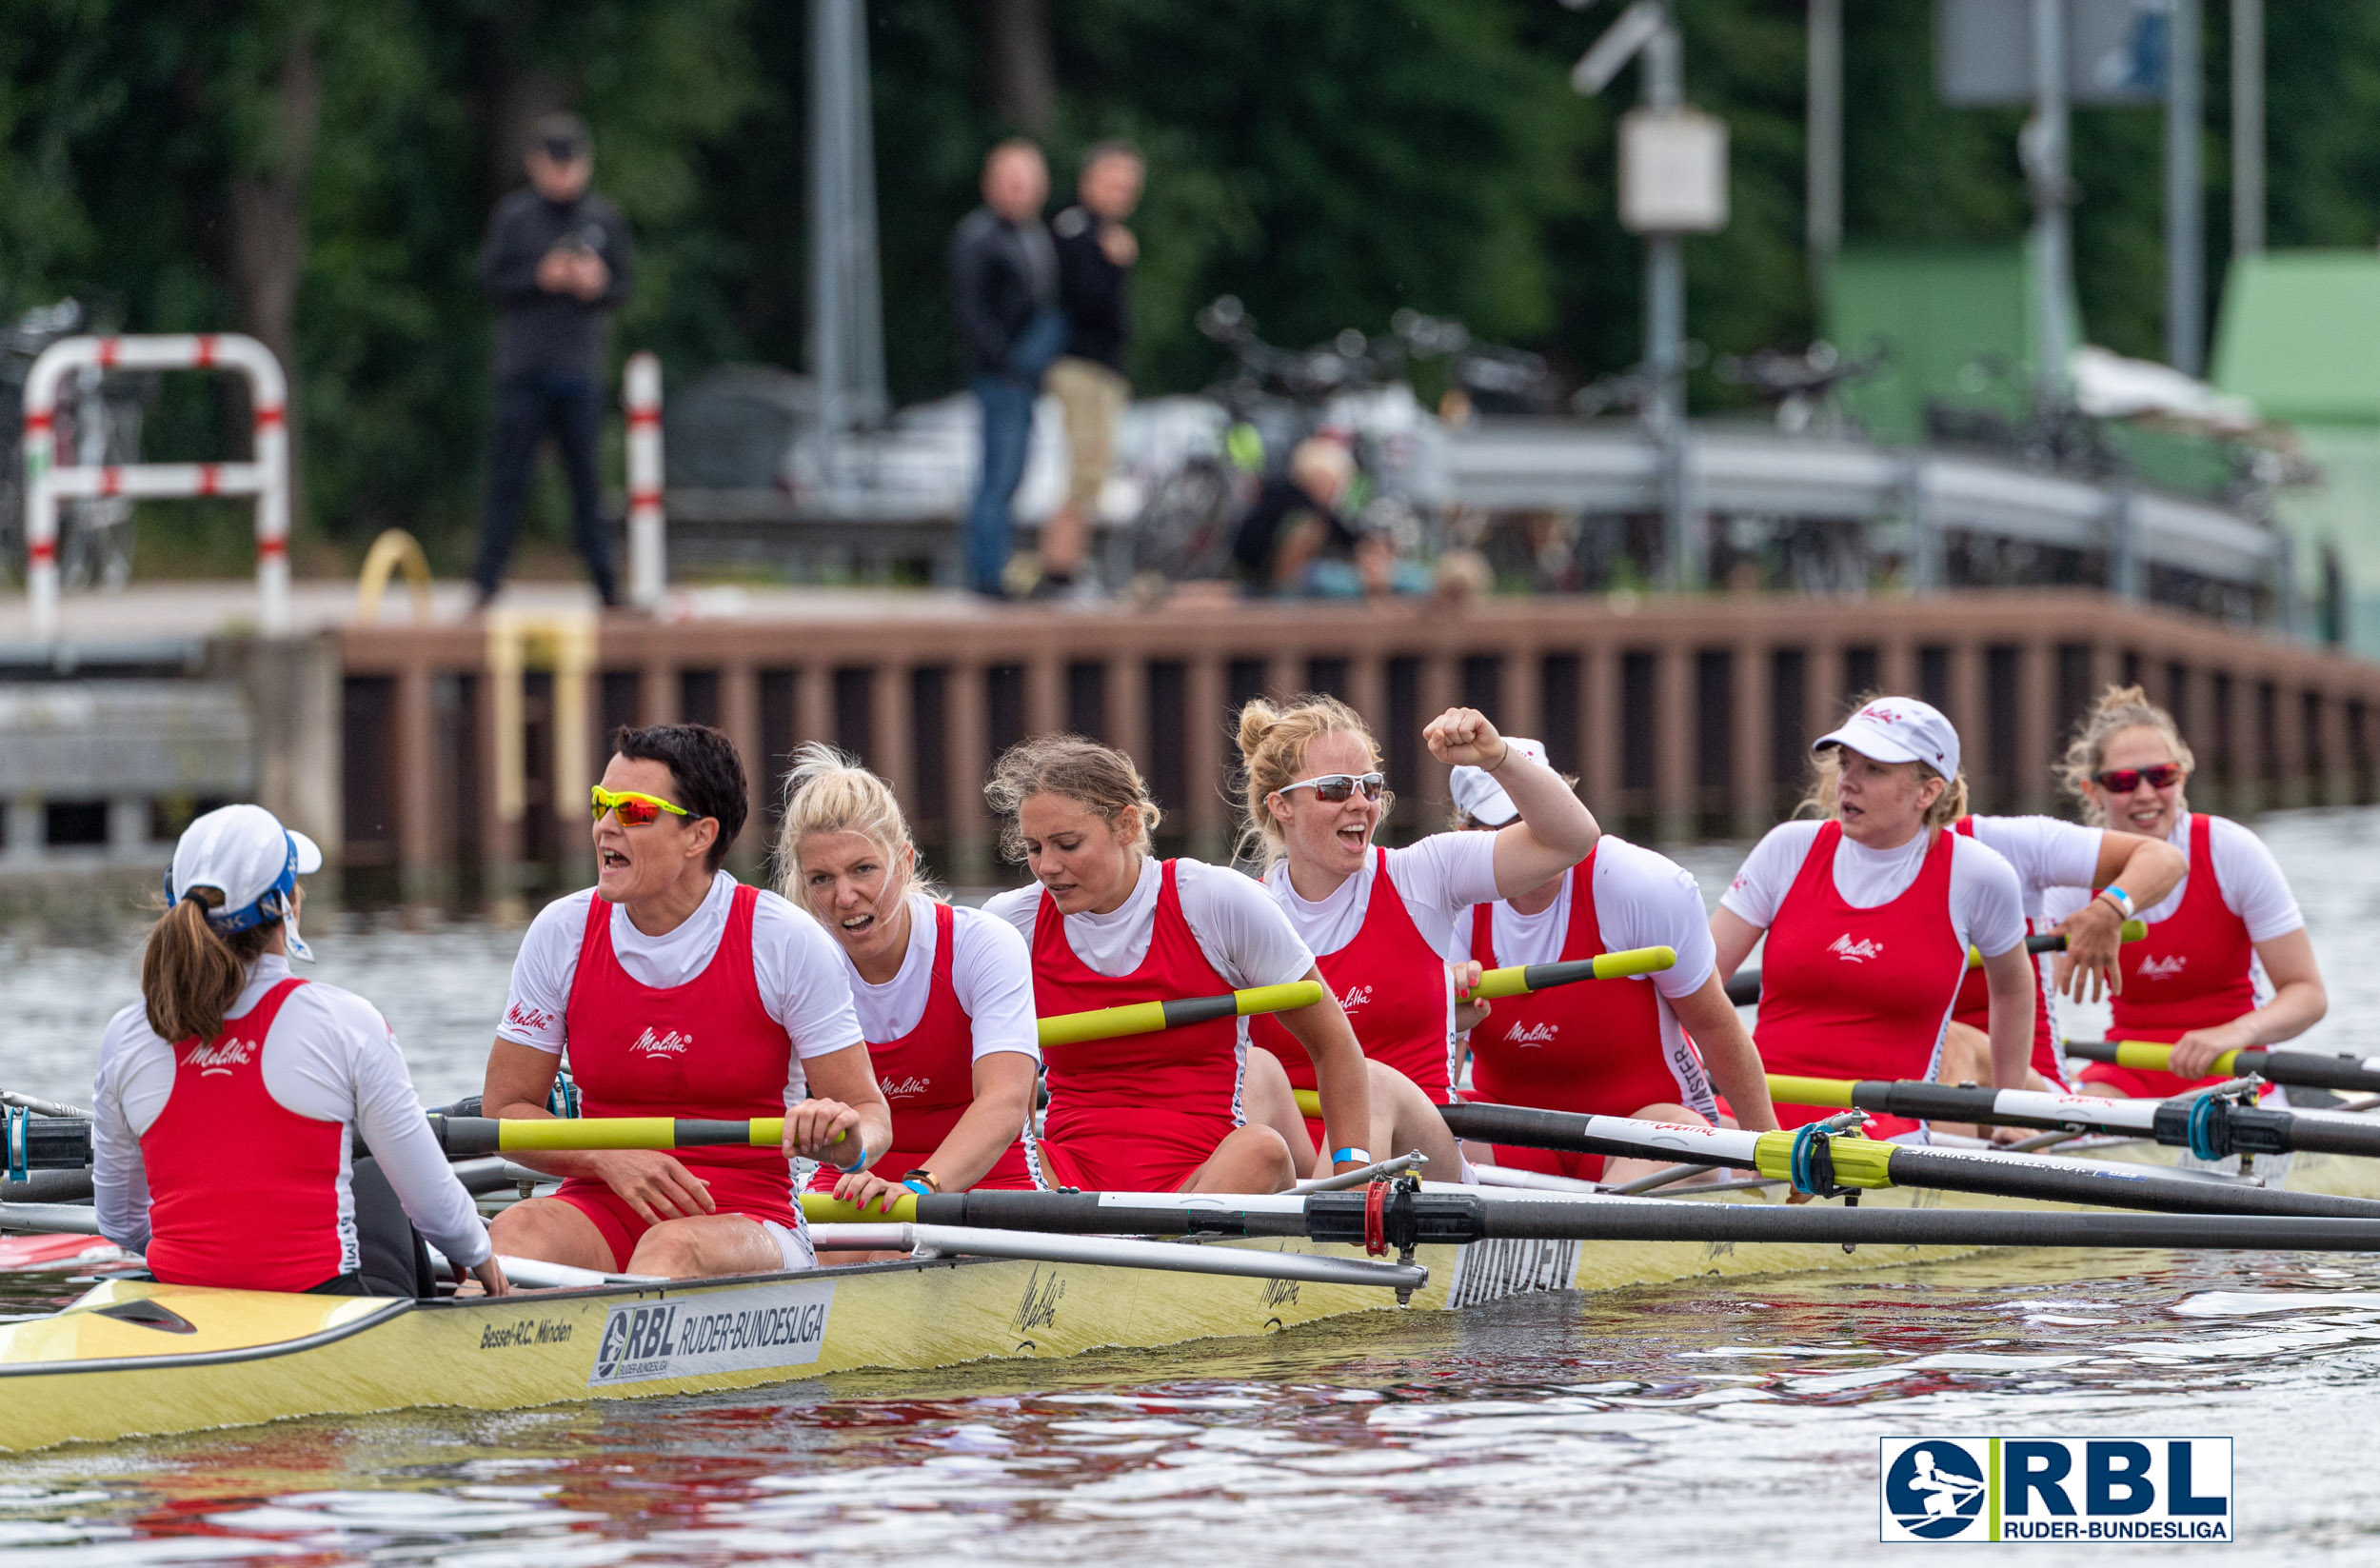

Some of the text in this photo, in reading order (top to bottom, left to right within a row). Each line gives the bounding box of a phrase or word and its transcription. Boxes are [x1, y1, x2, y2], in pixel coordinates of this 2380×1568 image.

[1336, 986, 1371, 1009] elitta
[534, 1318, 572, 1344] Minden
[624, 1305, 677, 1360] RBL
[677, 1303, 825, 1356] RUDER-BUNDESLIGA
